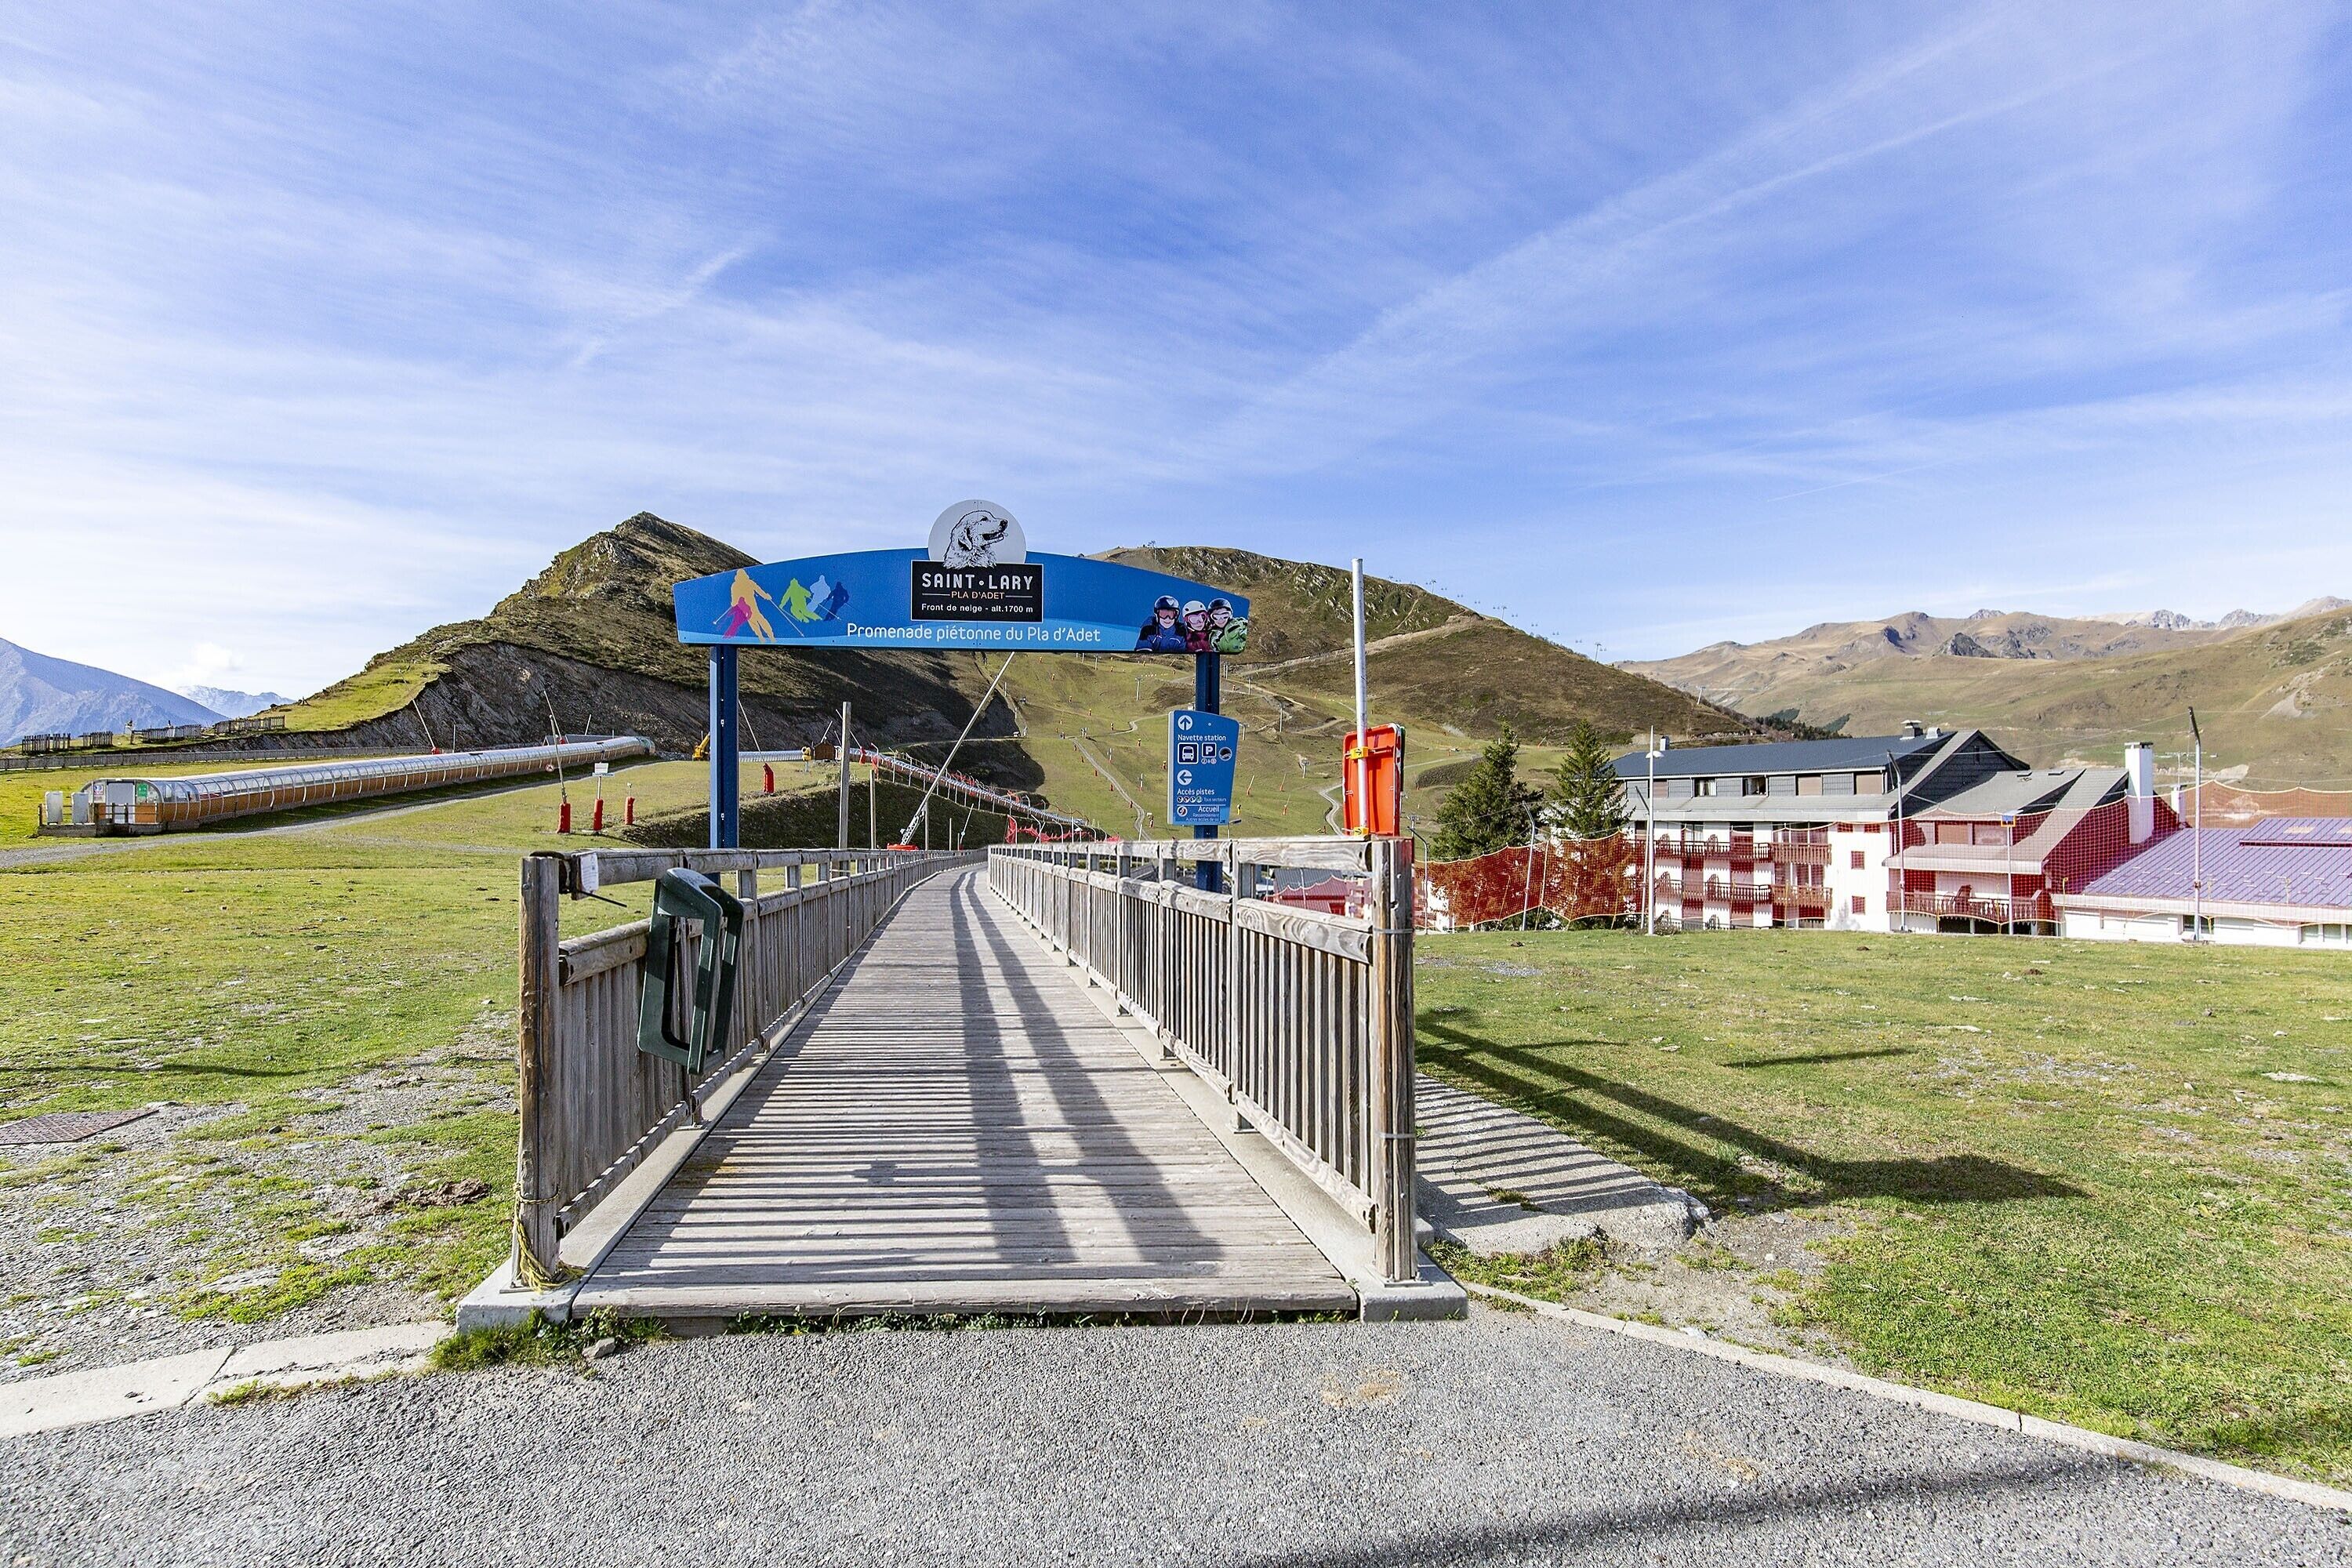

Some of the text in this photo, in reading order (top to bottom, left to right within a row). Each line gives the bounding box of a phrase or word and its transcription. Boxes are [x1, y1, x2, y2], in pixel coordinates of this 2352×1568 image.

[922, 572, 1033, 590] SAINT LARY
[951, 590, 969, 599] PLA
[921, 603, 944, 612] Front
[946, 604, 957, 612] de
[960, 604, 982, 614] neige
[991, 604, 1024, 613] alt.1700
[847, 622, 1102, 642] Promenade piétonne du Pla d'Adet
[1205, 746, 1214, 755] P
[1196, 788, 1215, 797] pistes
